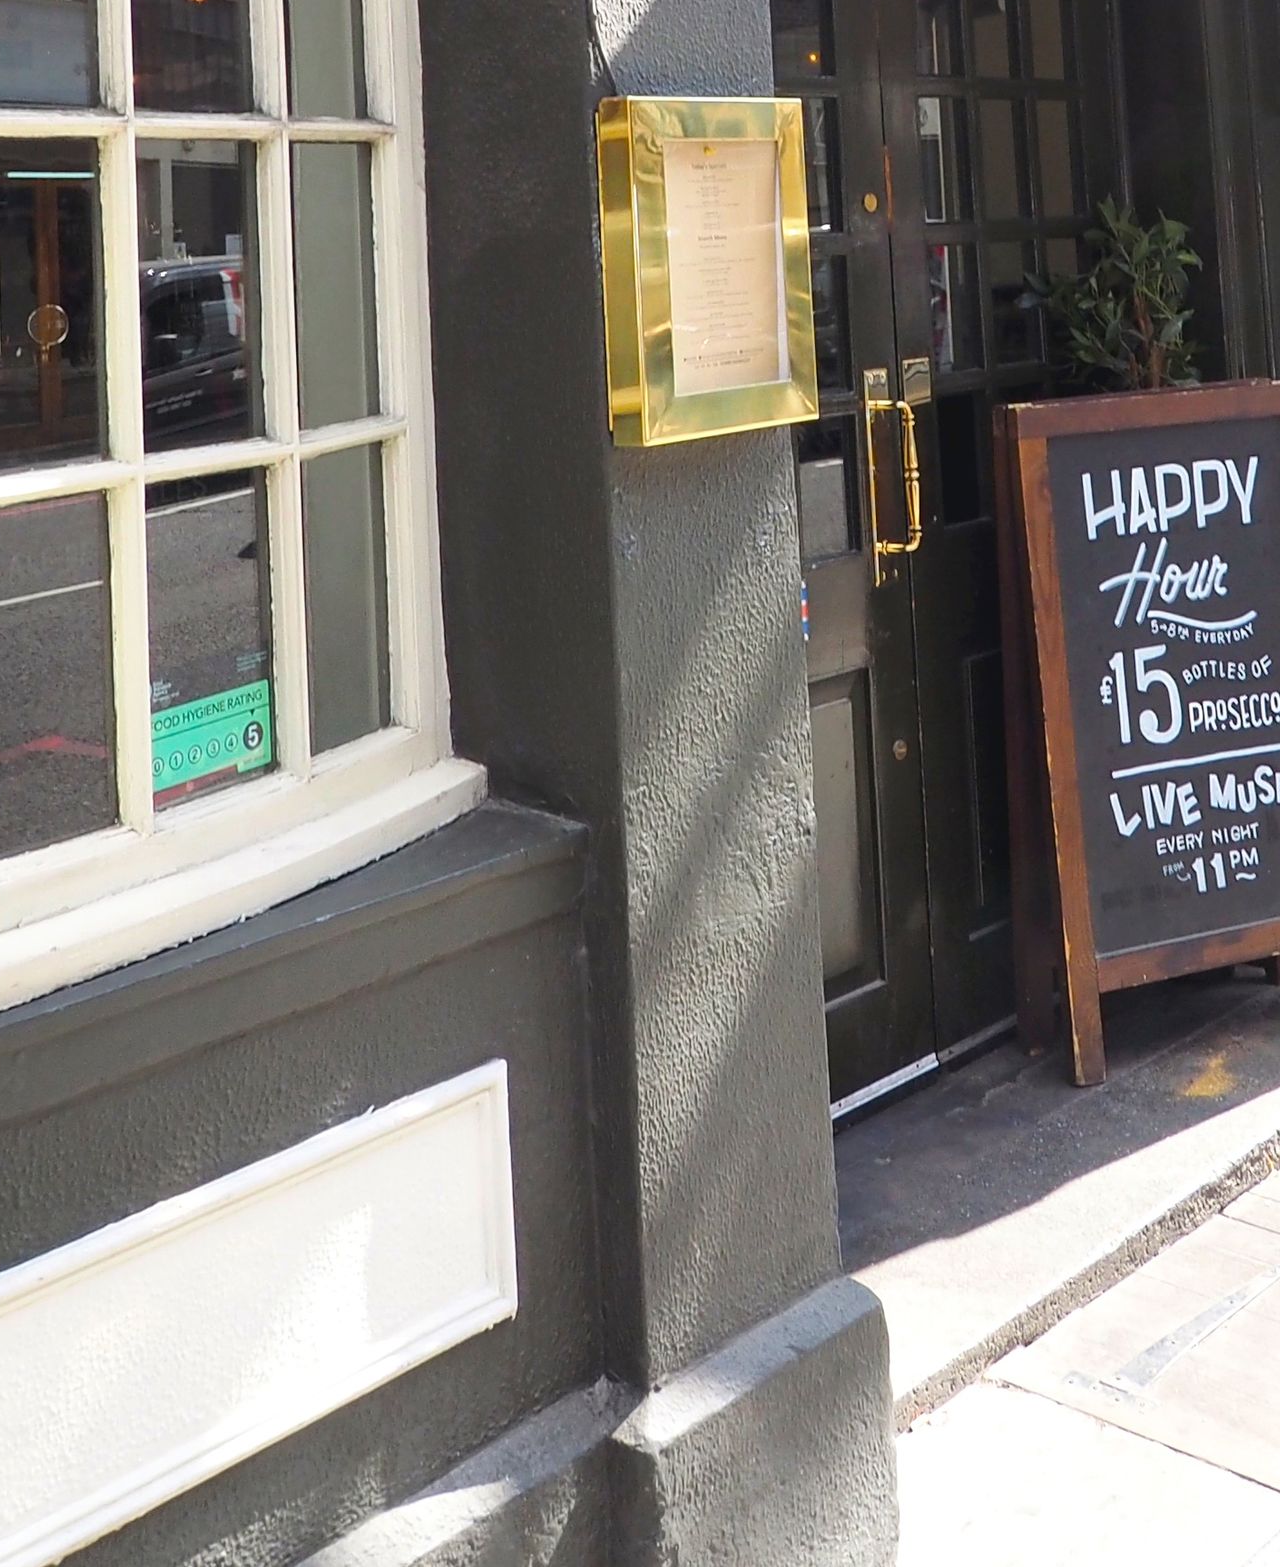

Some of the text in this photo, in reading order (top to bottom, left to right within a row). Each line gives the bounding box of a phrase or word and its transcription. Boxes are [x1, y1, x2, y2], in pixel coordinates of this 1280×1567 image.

[1082, 456, 1259, 541] HAPPY
[1099, 538, 1229, 628] Hour
[1194, 622, 1255, 645] EVERYDAY
[1181, 654, 1273, 686] BOTTLES OF
[151, 689, 263, 732] OOD HYGIENE RATING
[1099, 644, 1183, 745] £15
[247, 724, 259, 748] 5
[1109, 781, 1202, 838] LIVE
[1156, 821, 1261, 856] EVERY NIGHT
[1191, 852, 1228, 894] 11
[1229, 847, 1259, 870] PM
